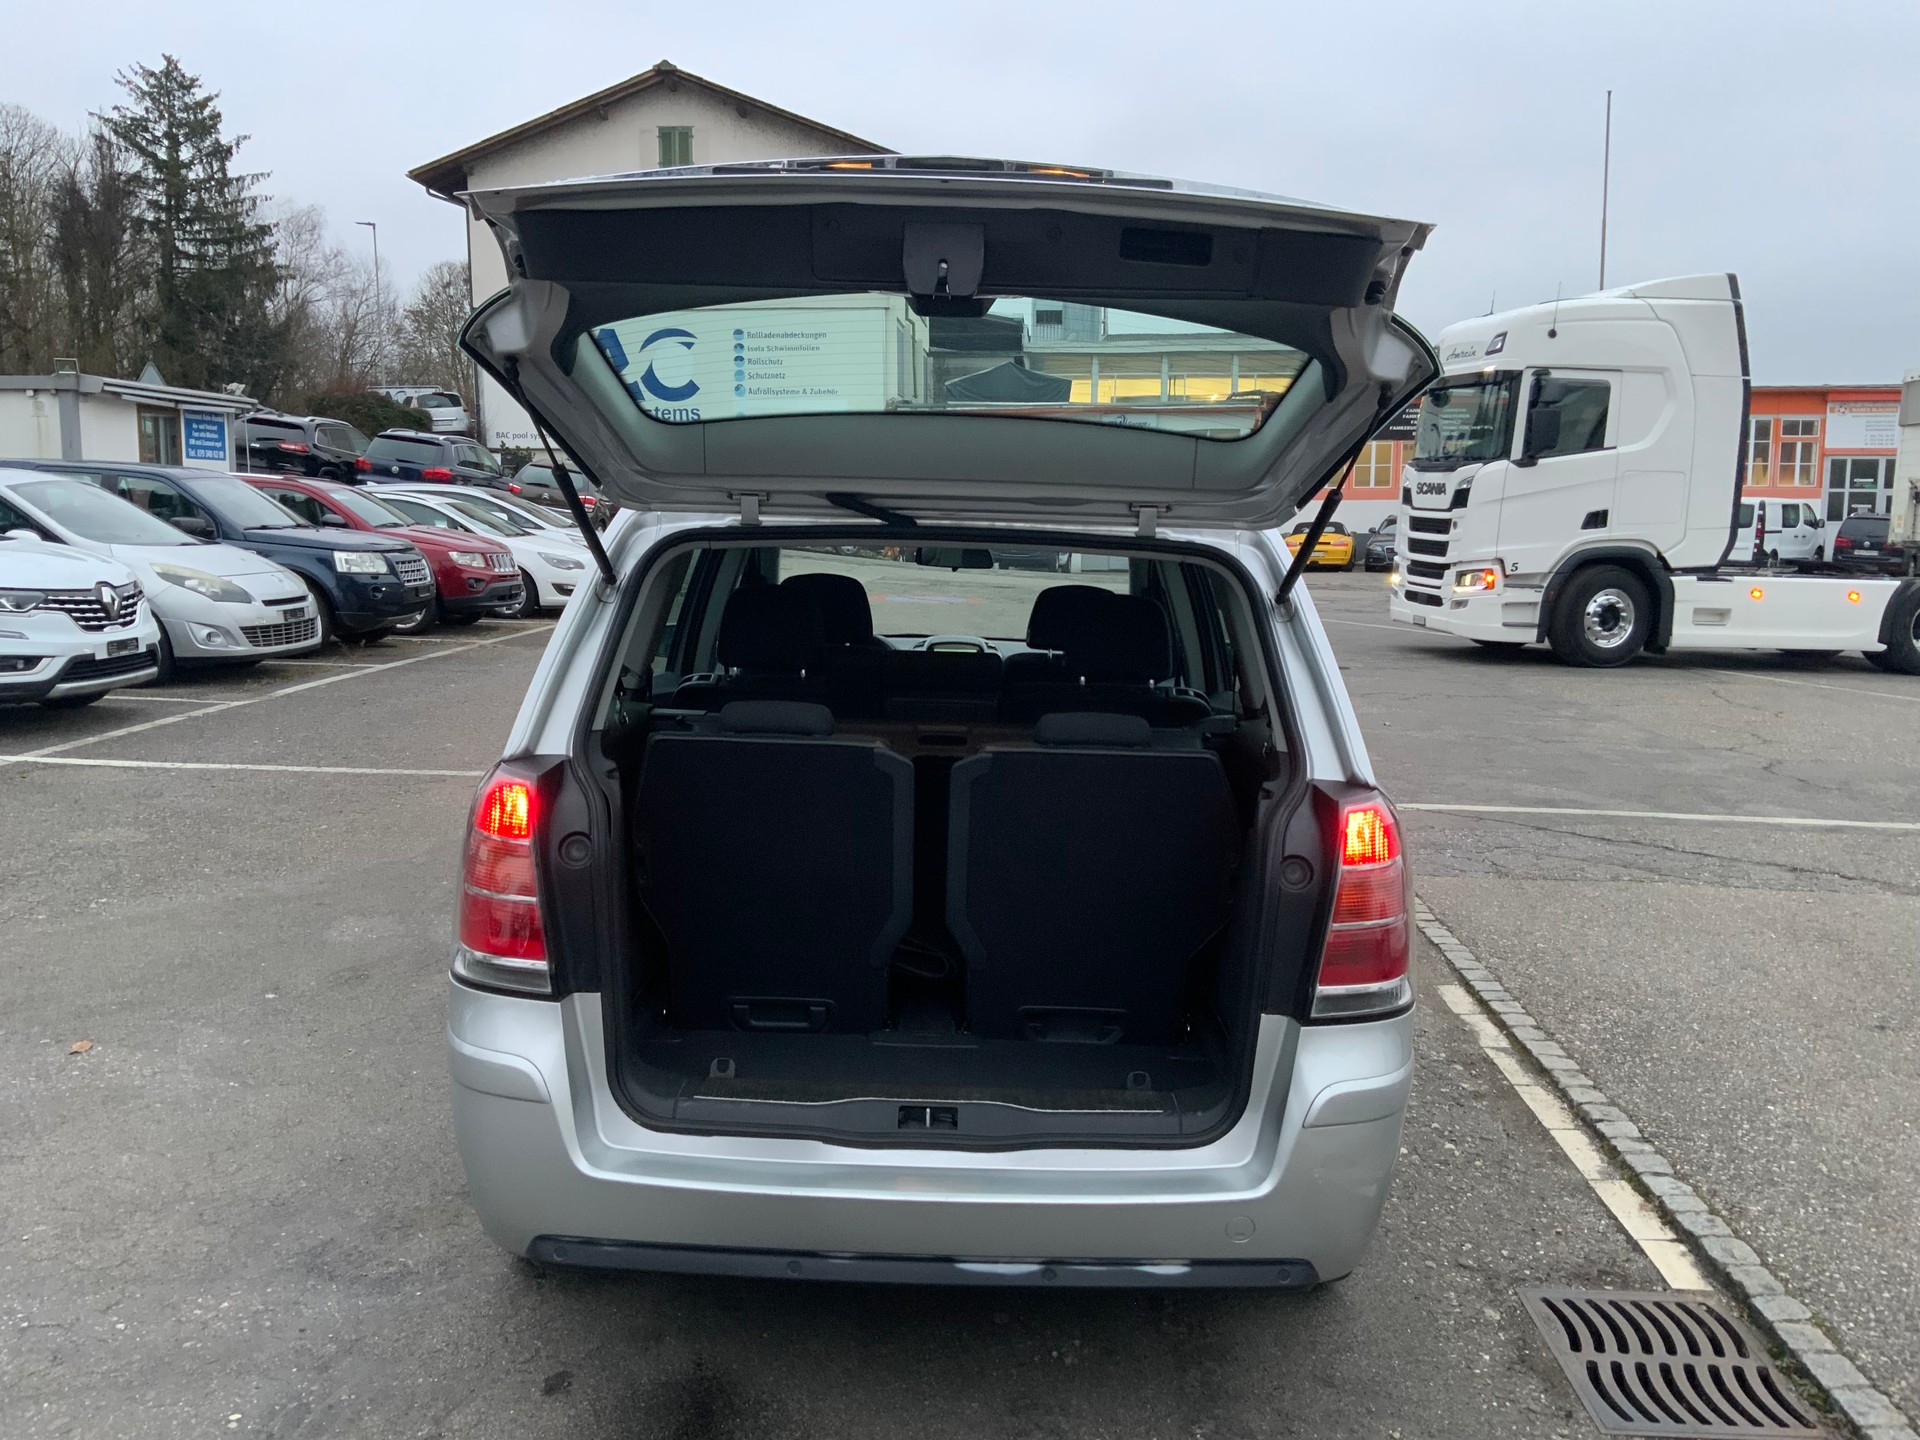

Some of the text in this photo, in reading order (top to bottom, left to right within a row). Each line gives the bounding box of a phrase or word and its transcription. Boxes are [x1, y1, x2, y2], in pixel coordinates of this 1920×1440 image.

[747, 358, 783, 366] Rollschutz
[747, 372, 785, 380] Schutznetz
[748, 387, 800, 396] Aufrollsysteme
[645, 406, 701, 422] tems
[512, 432, 528, 440] pool
[1416, 482, 1447, 495] SCANIA
[1510, 562, 1519, 572] 5
